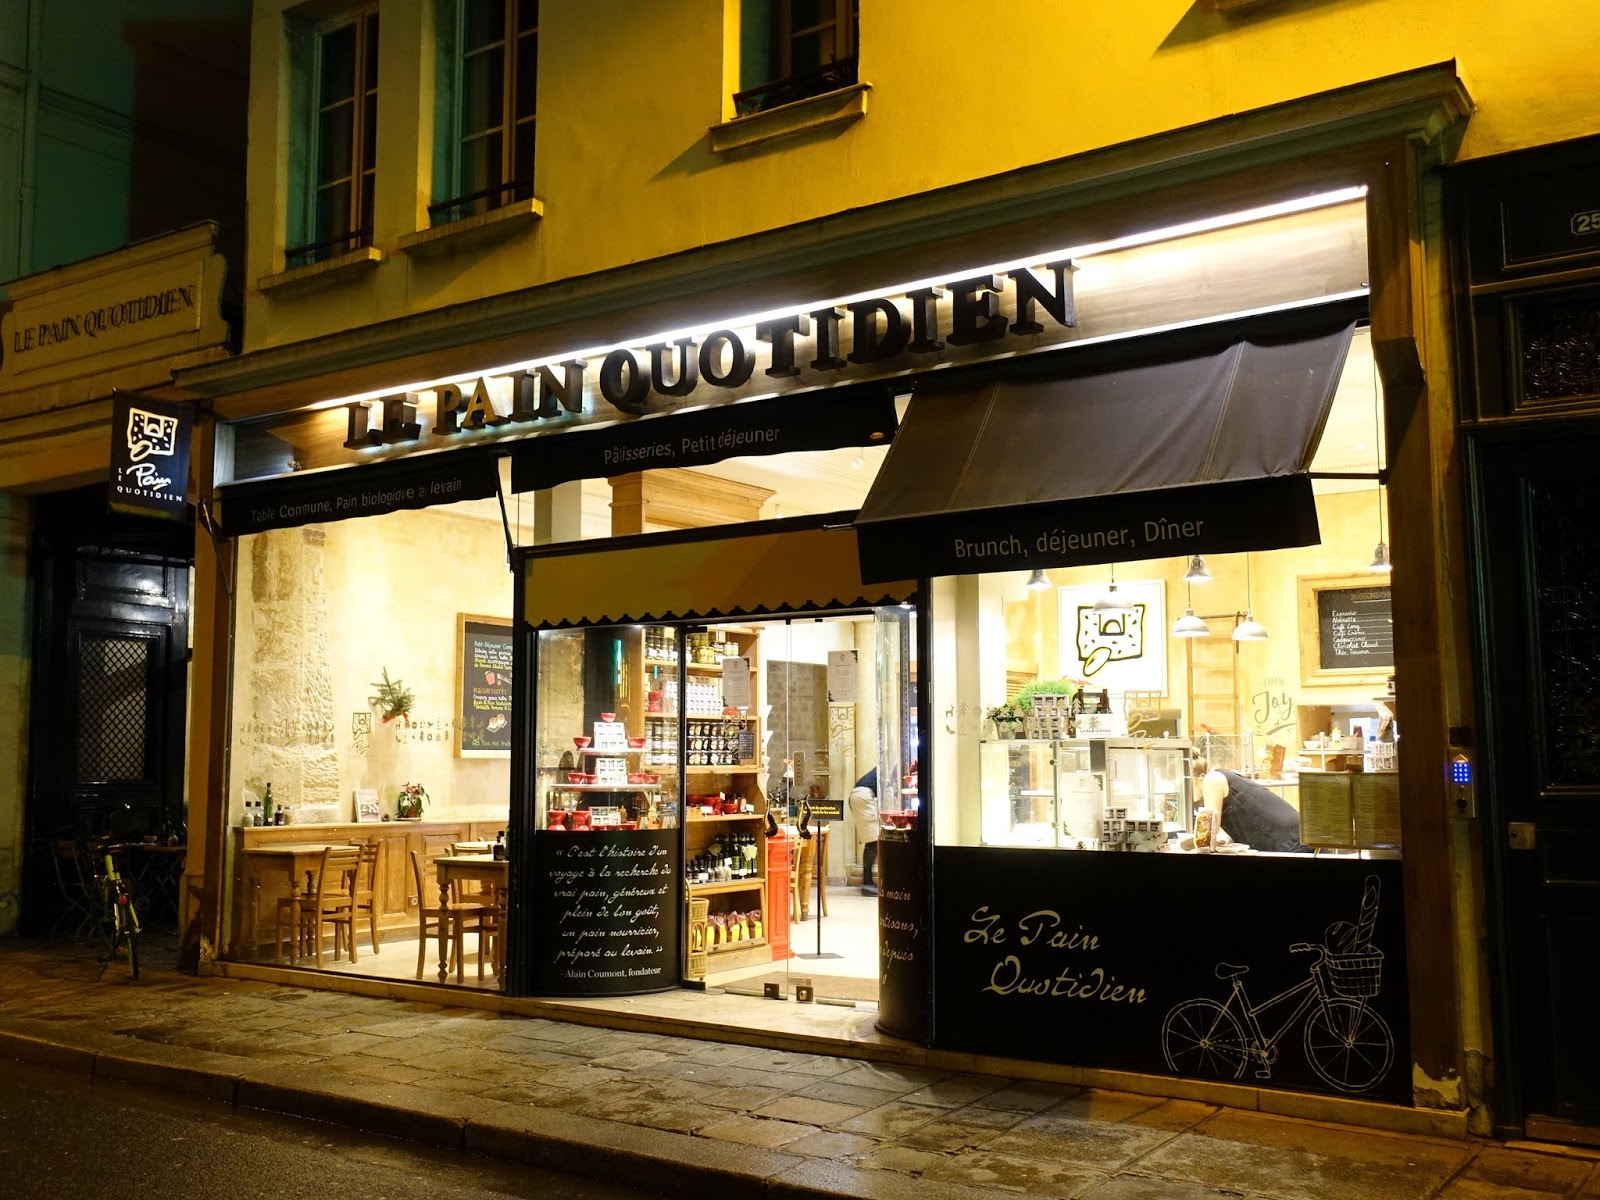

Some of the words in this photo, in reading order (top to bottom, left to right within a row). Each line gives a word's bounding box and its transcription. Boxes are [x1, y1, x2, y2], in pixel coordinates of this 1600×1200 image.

[1577, 213, 1600, 232] 25
[14, 327, 35, 353] LE
[38, 315, 81, 347] PAIN
[84, 285, 195, 337] QUOTIDIEN
[343, 393, 421, 450] LE
[432, 358, 588, 435] PAIN
[599, 259, 1080, 415] QUOTIDIEN
[604, 440, 675, 464] Pâtisseries,
[682, 435, 716, 454] Petit
[718, 428, 780, 448] déjeuner
[126, 463, 172, 491] Pain
[117, 486, 182, 502] QUOTIDIEN
[251, 510, 276, 524] Table
[336, 495, 357, 508] Pain
[430, 478, 462, 494] levain
[954, 535, 1028, 558] Brunch,
[1036, 528, 1136, 554] déjeuner,
[1144, 518, 1204, 542] Dîner
[1252, 691, 1296, 723] Joy
[598, 844, 646, 858] l'histoire
[549, 869, 584, 884] voyage
[588, 867, 595, 877] à
[599, 864, 611, 878] la
[614, 862, 659, 877] recherche
[660, 863, 671, 875] du
[554, 888, 578, 897] vrai
[576, 888, 609, 904] pain,
[608, 886, 656, 904] généreux
[657, 884, 669, 895] et
[886, 887, 911, 901] main
[559, 905, 593, 924] plein
[596, 905, 609, 917] de
[613, 904, 632, 917] bon
[630, 903, 659, 923] goût,
[575, 928, 606, 944] pain
[610, 926, 659, 938] nourricier,
[963, 905, 1007, 945] Le
[1018, 909, 1100, 950] Pain
[553, 948, 601, 964] préparé
[604, 950, 617, 958] au
[620, 943, 653, 957] levain.
[882, 940, 914, 969] depuis
[565, 969, 586, 978] Alain
[587, 969, 627, 979] Coumont,
[628, 966, 662, 977] fondateur
[982, 955, 1148, 1005] Quotidien
